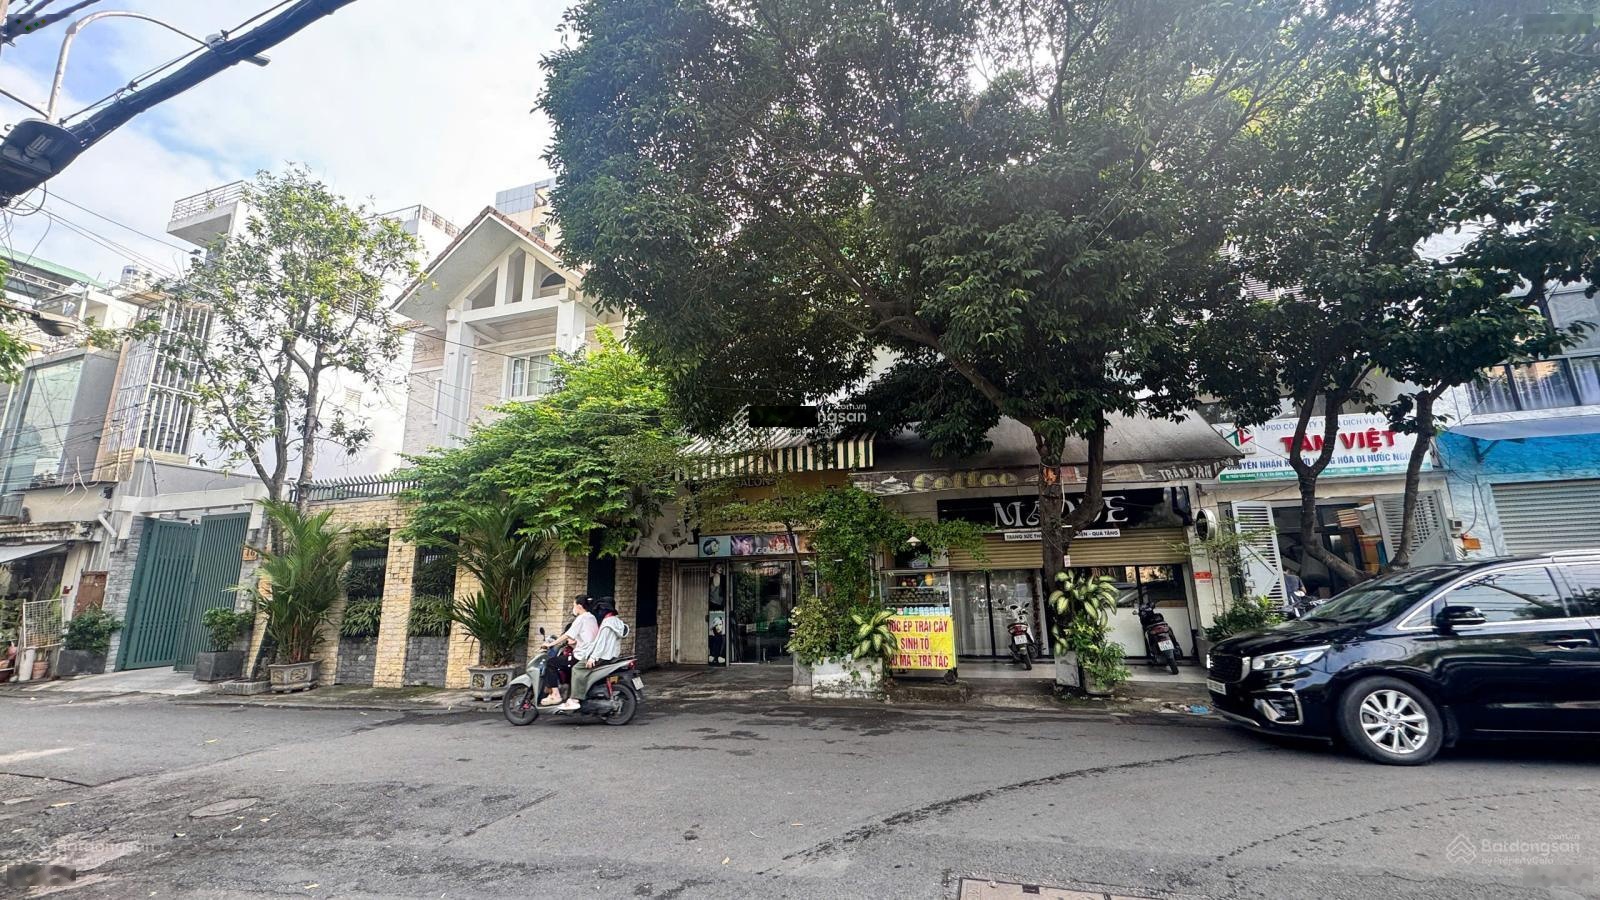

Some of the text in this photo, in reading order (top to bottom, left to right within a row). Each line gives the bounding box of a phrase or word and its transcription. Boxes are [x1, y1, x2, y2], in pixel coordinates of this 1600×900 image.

[1339, 427, 1398, 453] VIỆT
[993, 495, 1129, 528] MAE
[933, 618, 948, 632] CÂY
[900, 637, 919, 650] SINH
